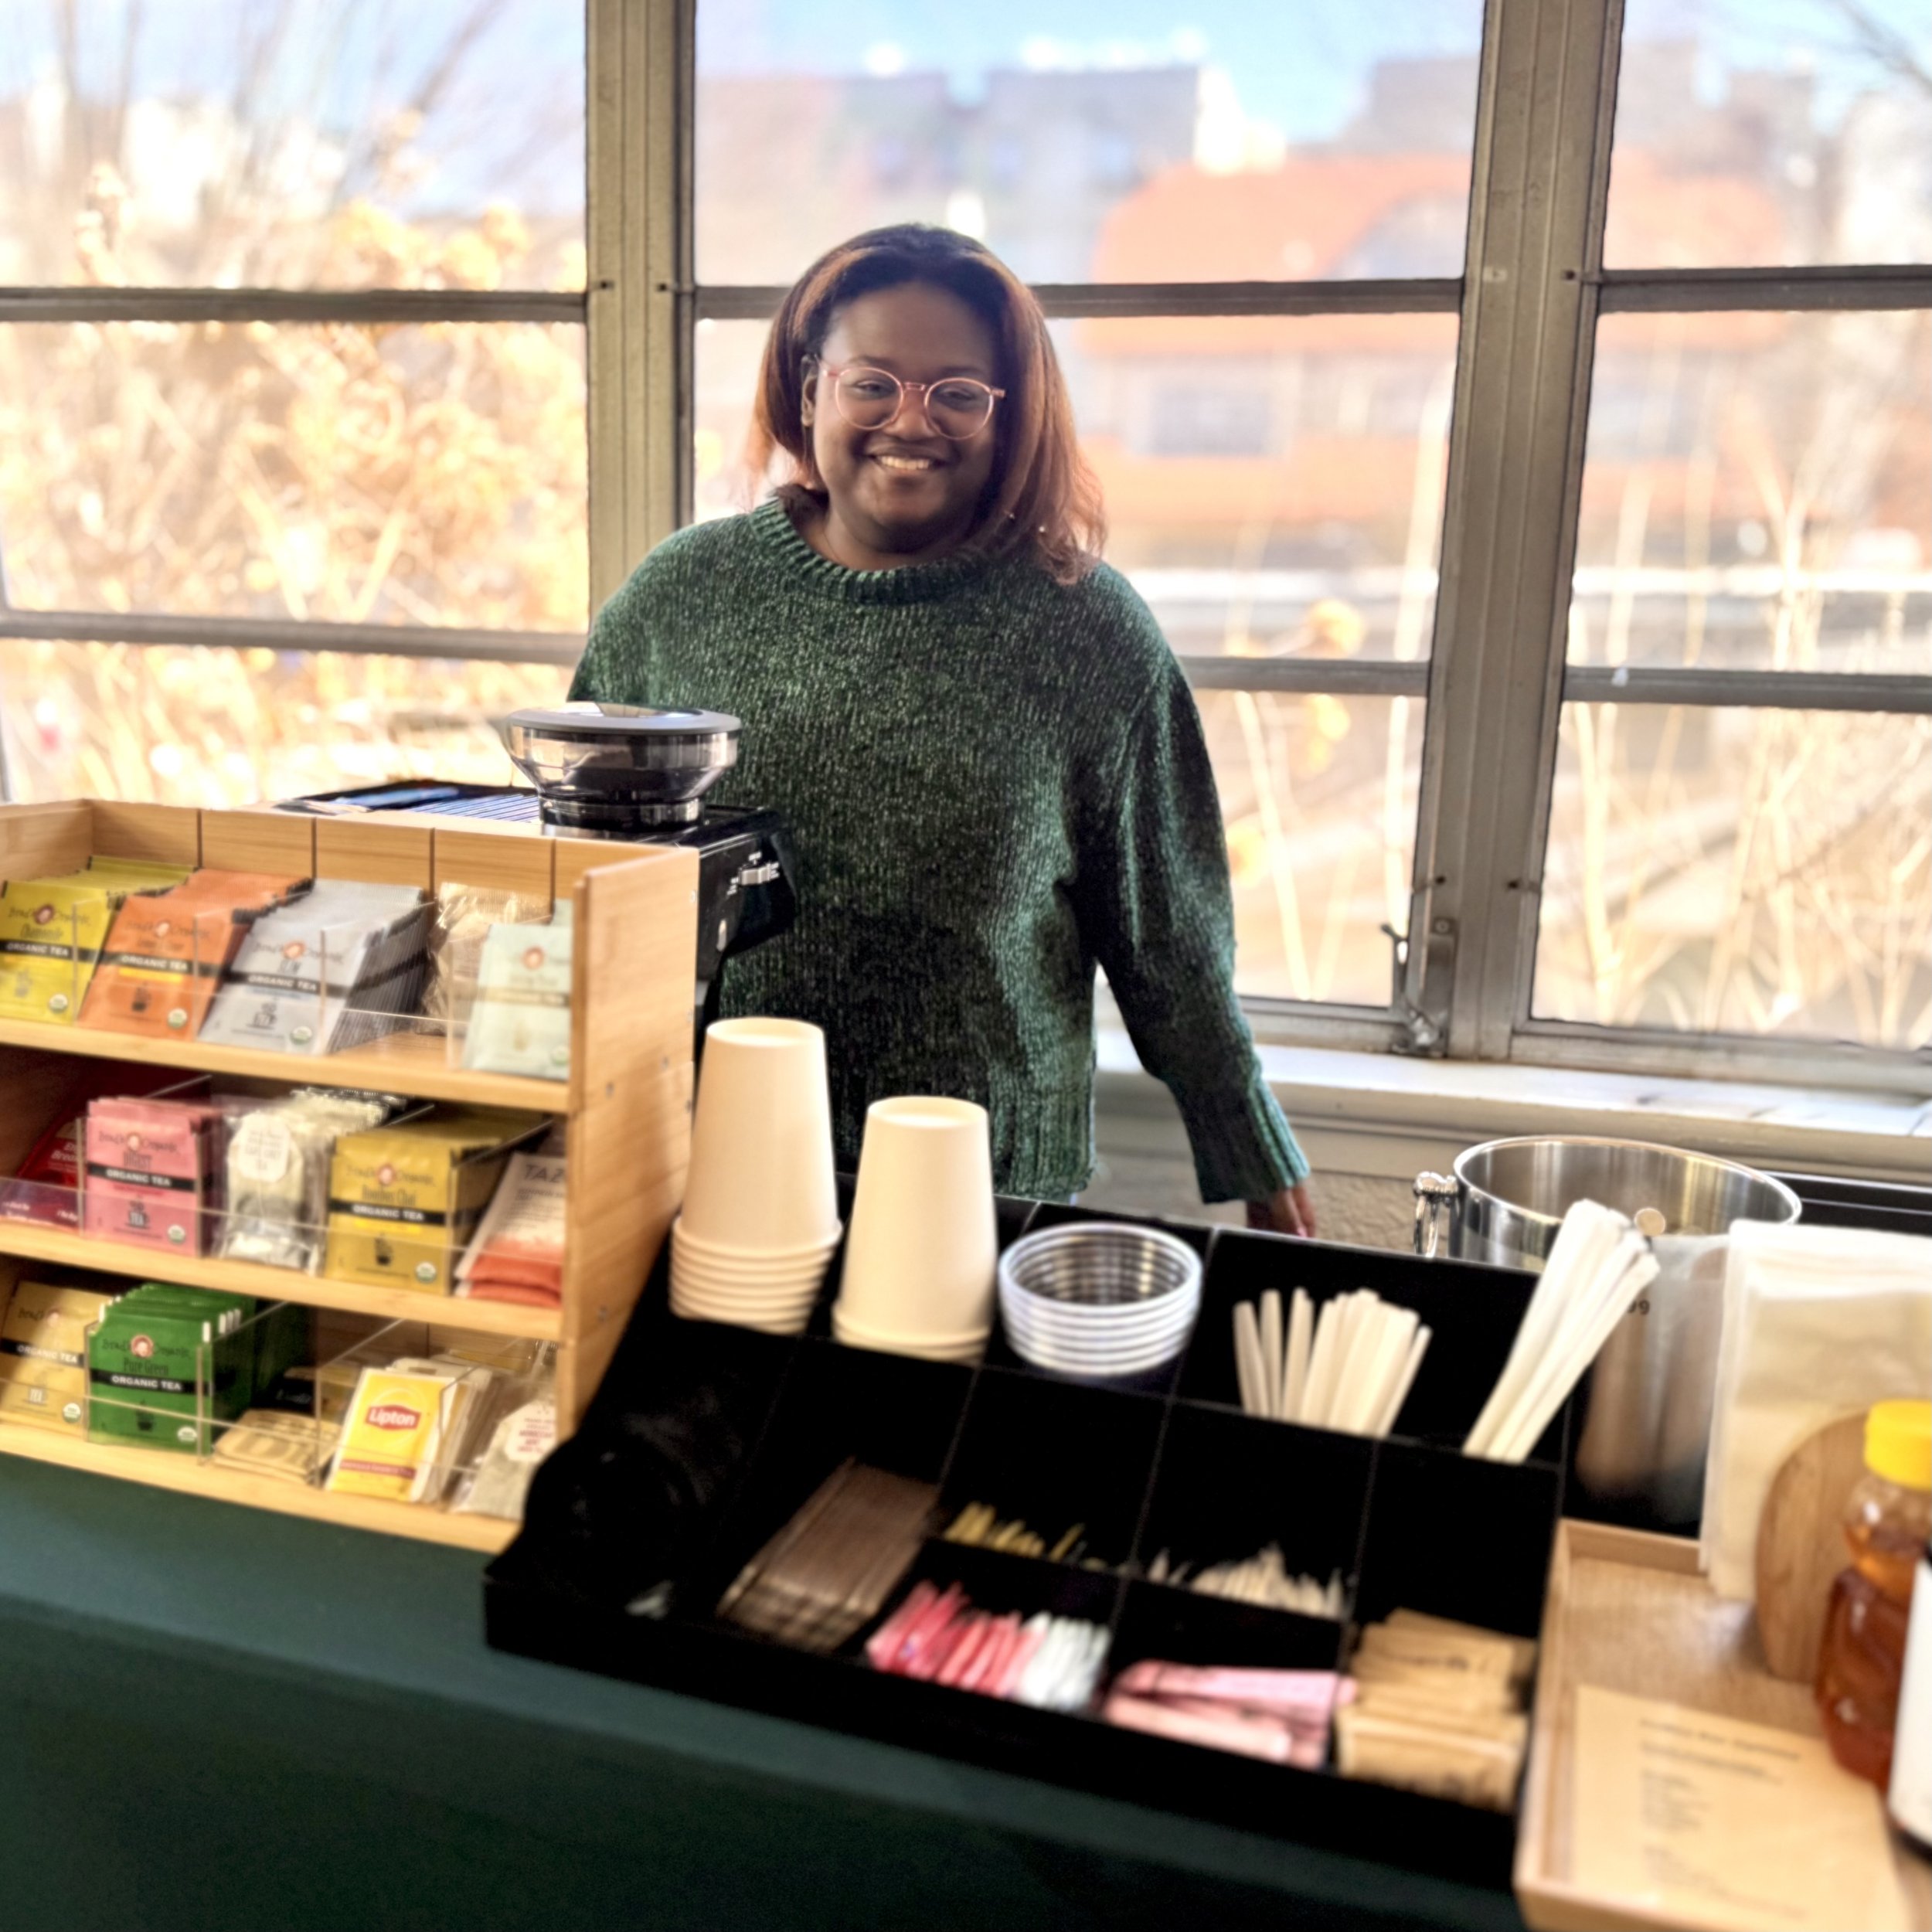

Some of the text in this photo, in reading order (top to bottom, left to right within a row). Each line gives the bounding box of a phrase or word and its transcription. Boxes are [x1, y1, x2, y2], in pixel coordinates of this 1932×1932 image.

[7, 942, 69, 957] ORGANIC TEA
[121, 954, 188, 972] ORGANIC TEA
[248, 975, 317, 992] ORGANIC TEA
[106, 1168, 172, 1187] ORGANIC TEA
[525, 1164, 565, 1183] TAZ
[352, 1204, 424, 1221] ORGANIC TEA
[17, 1345, 77, 1364] ORGANIC TEA
[111, 1376, 182, 1391] ORGANIC TEA
[369, 1407, 416, 1427] Lipton
